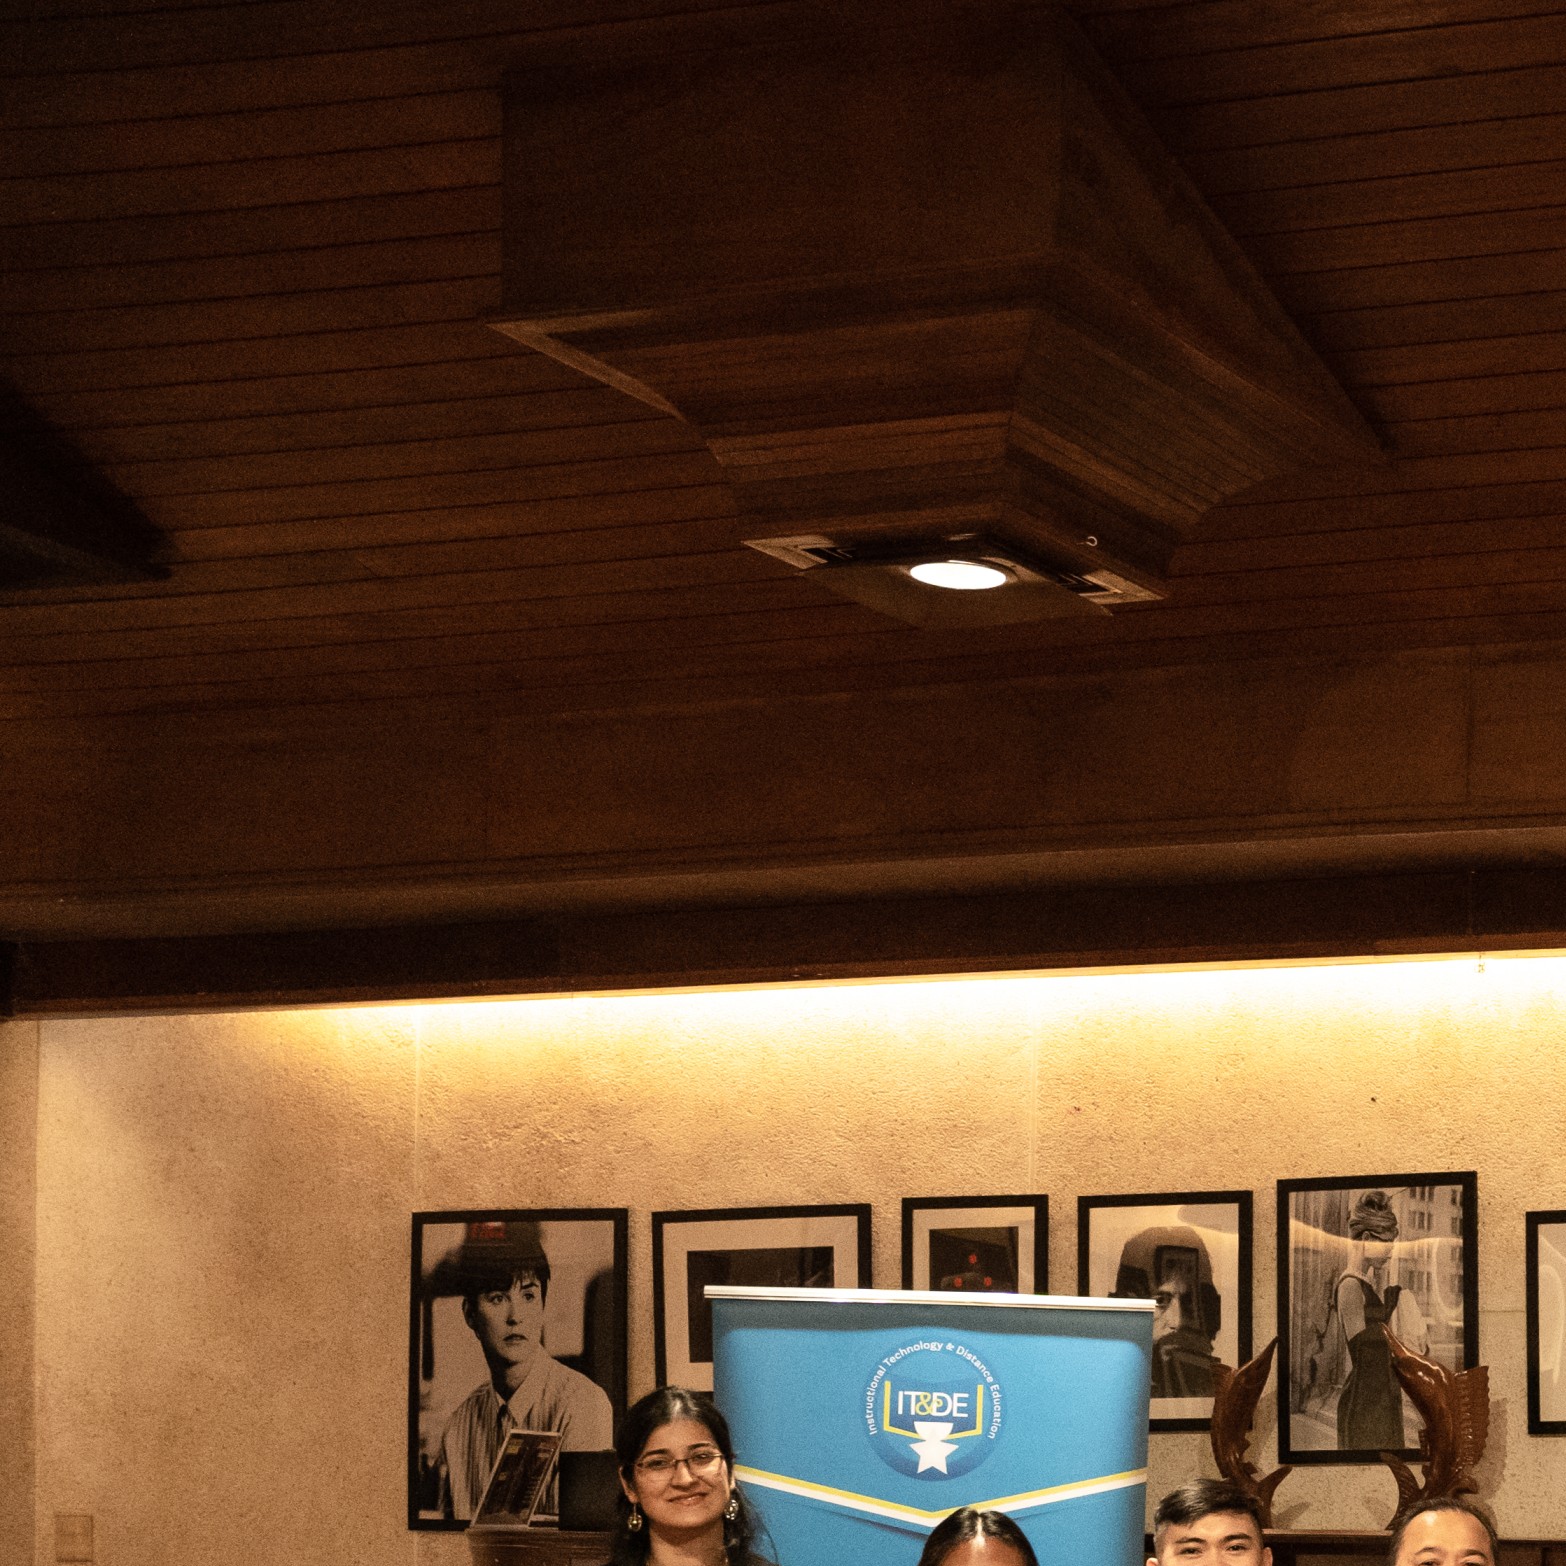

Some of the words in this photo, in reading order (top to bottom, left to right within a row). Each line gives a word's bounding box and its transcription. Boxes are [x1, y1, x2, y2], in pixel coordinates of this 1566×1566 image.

[865, 1365, 887, 1435] Instructional
[882, 1340, 943, 1367] Technology
[945, 1342, 955, 1351] &
[956, 1345, 994, 1383] Distance
[987, 1384, 1002, 1439] Education
[897, 1390, 969, 1418] IT&DE
